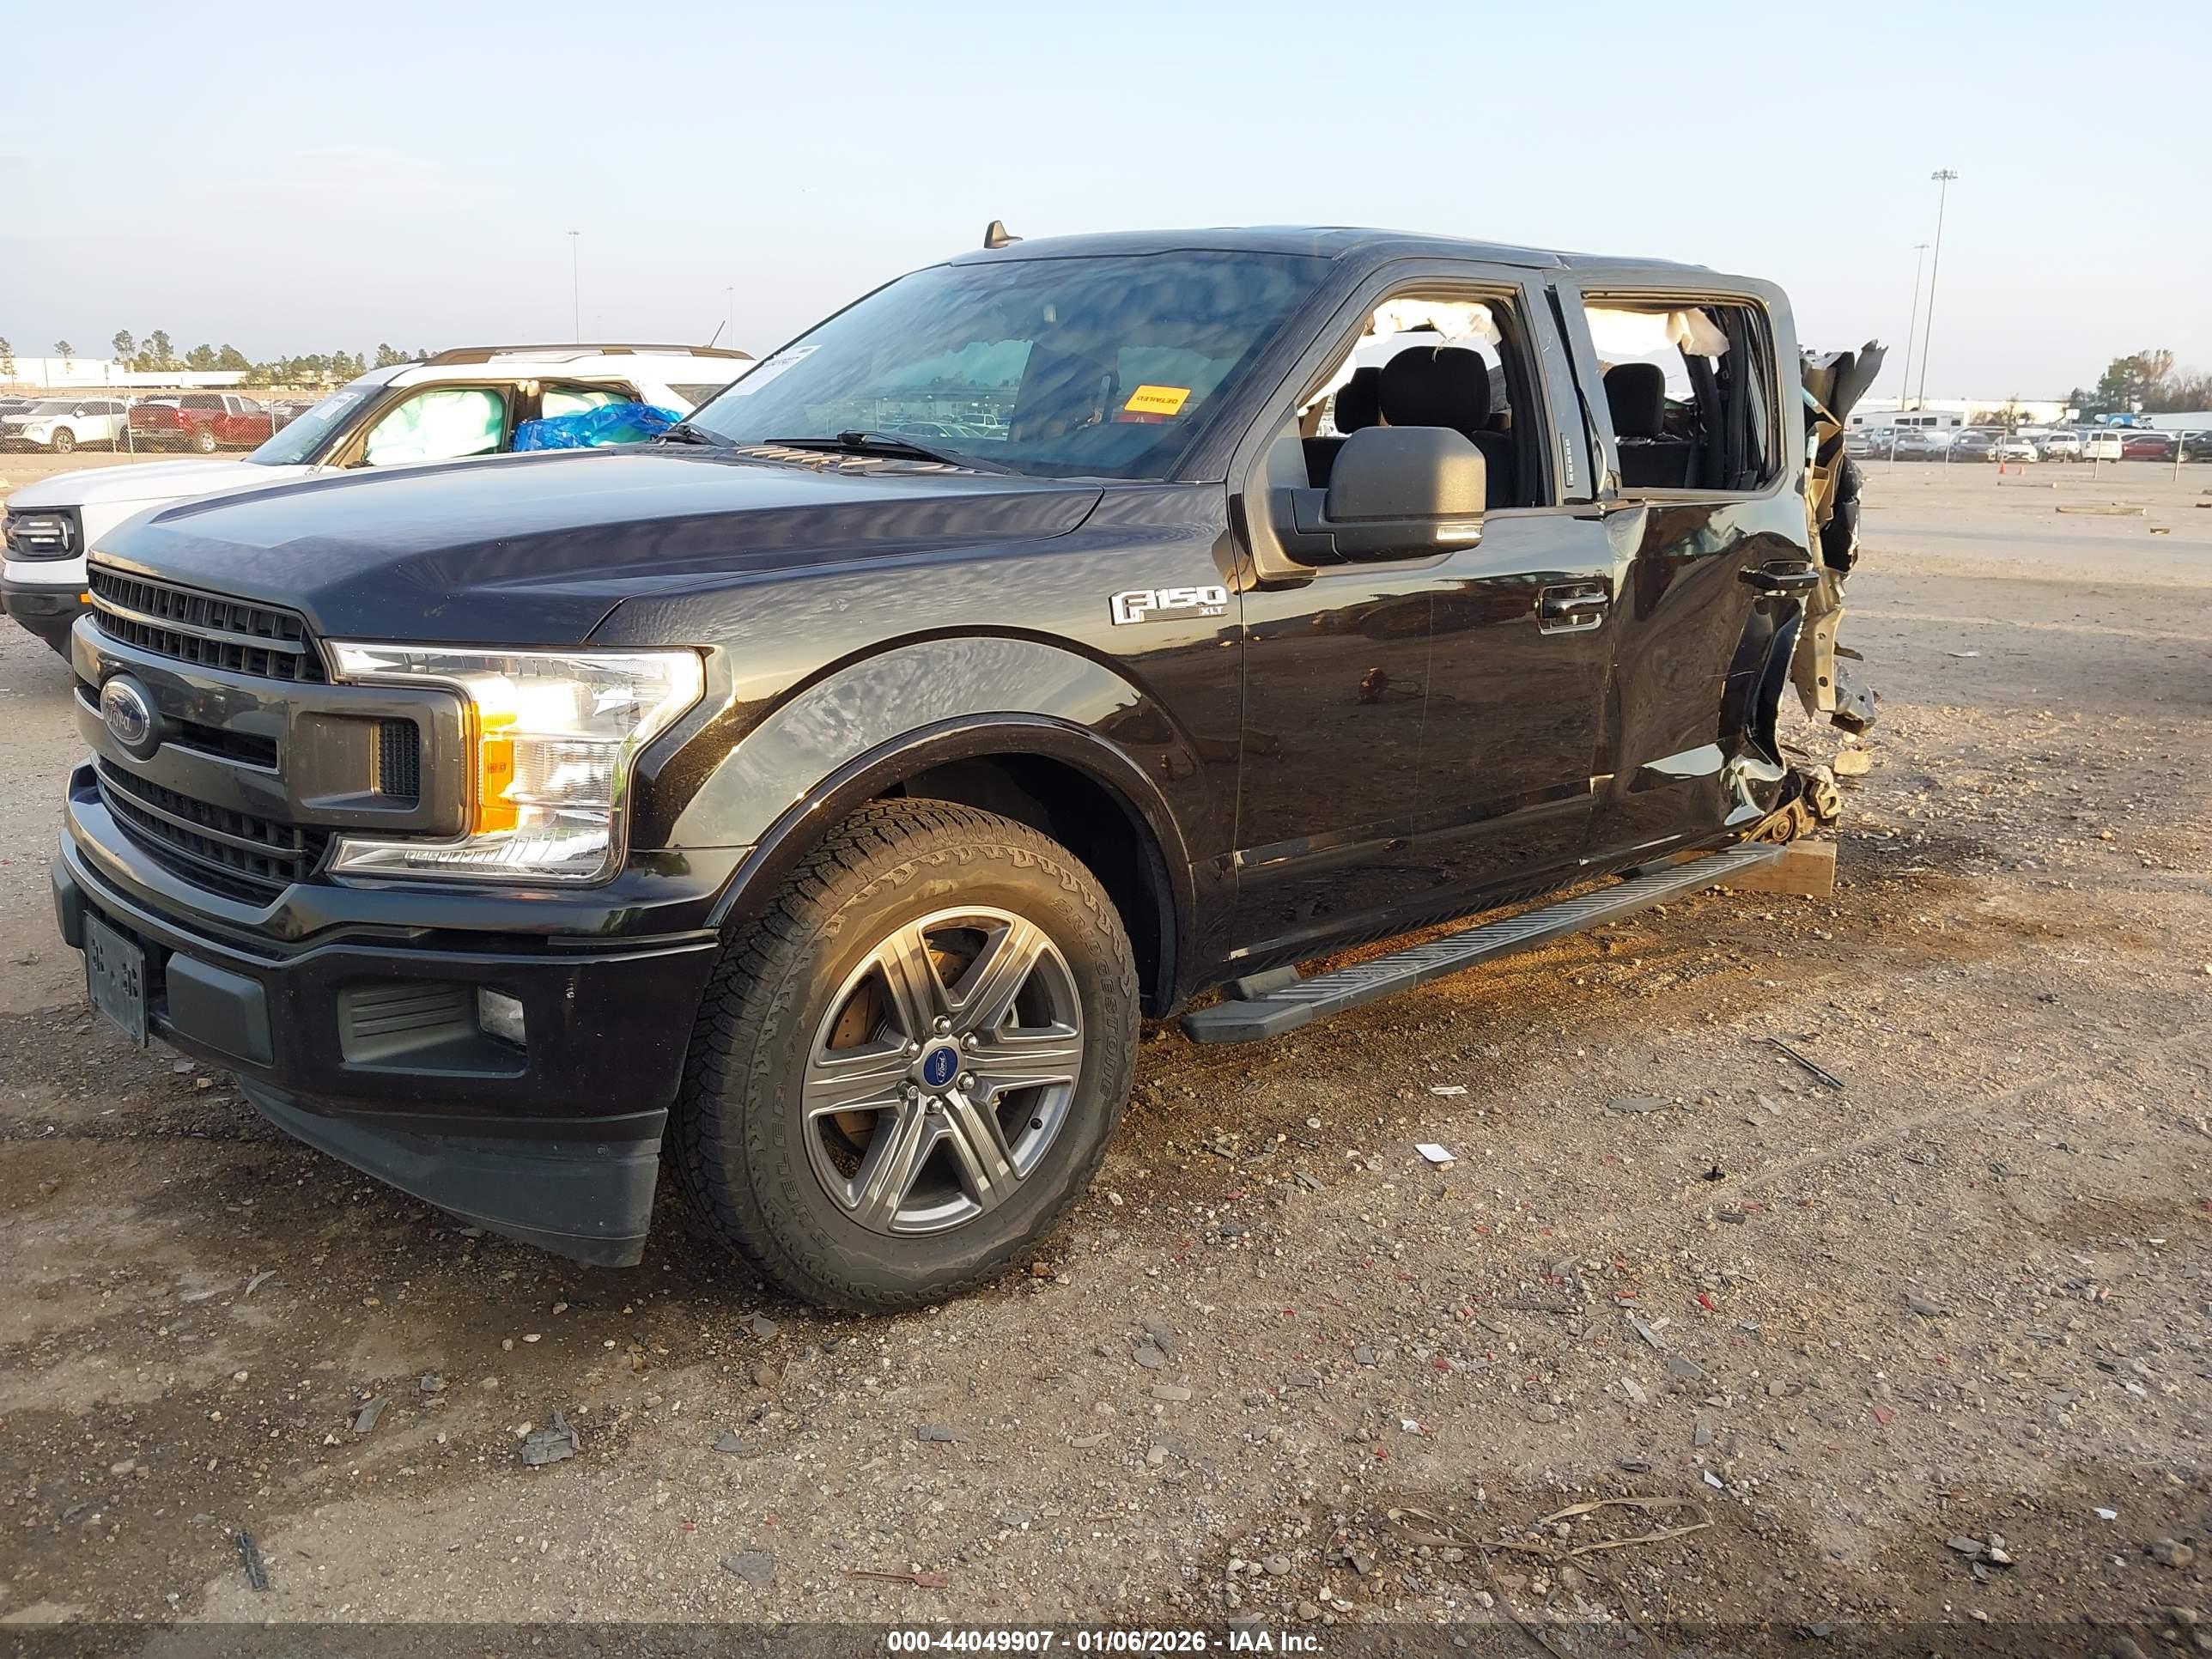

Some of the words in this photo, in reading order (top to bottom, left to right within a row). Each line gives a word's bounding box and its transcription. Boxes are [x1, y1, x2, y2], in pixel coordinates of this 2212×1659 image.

[1136, 395, 1179, 404] DETAILED
[1200, 606, 1224, 616] XLT
[1050, 898, 1120, 1100] BRIDGESTONE
[937, 1056, 946, 1078] Ford
[773, 1082, 838, 1249] DUELER
